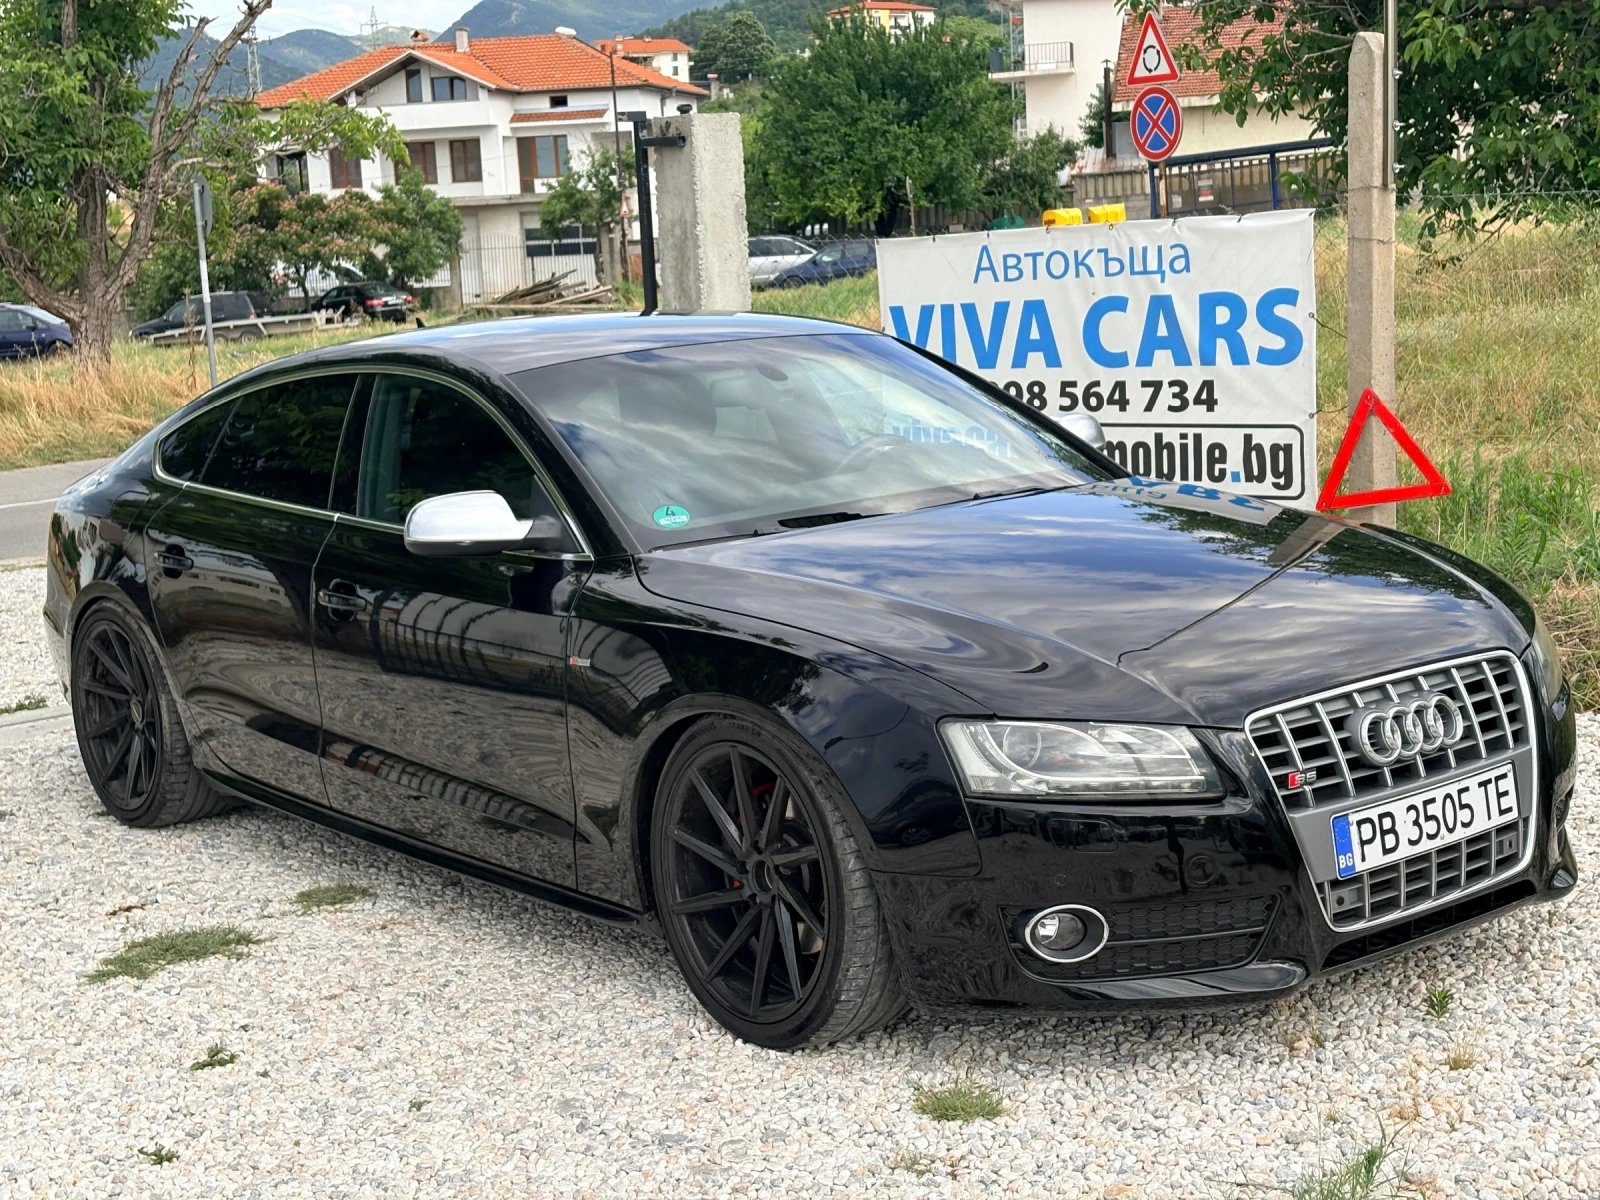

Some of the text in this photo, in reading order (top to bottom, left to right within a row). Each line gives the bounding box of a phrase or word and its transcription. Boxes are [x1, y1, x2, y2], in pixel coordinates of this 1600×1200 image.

[973, 243, 1191, 284] Автокъща
[889, 287, 1303, 370] VIVA CARS
[1058, 380, 1130, 412] 564
[1140, 379, 1218, 412] 734
[1295, 771, 1317, 785] S5
[1355, 772, 1513, 862] PB 3505 TE
[1338, 853, 1354, 869] BG
